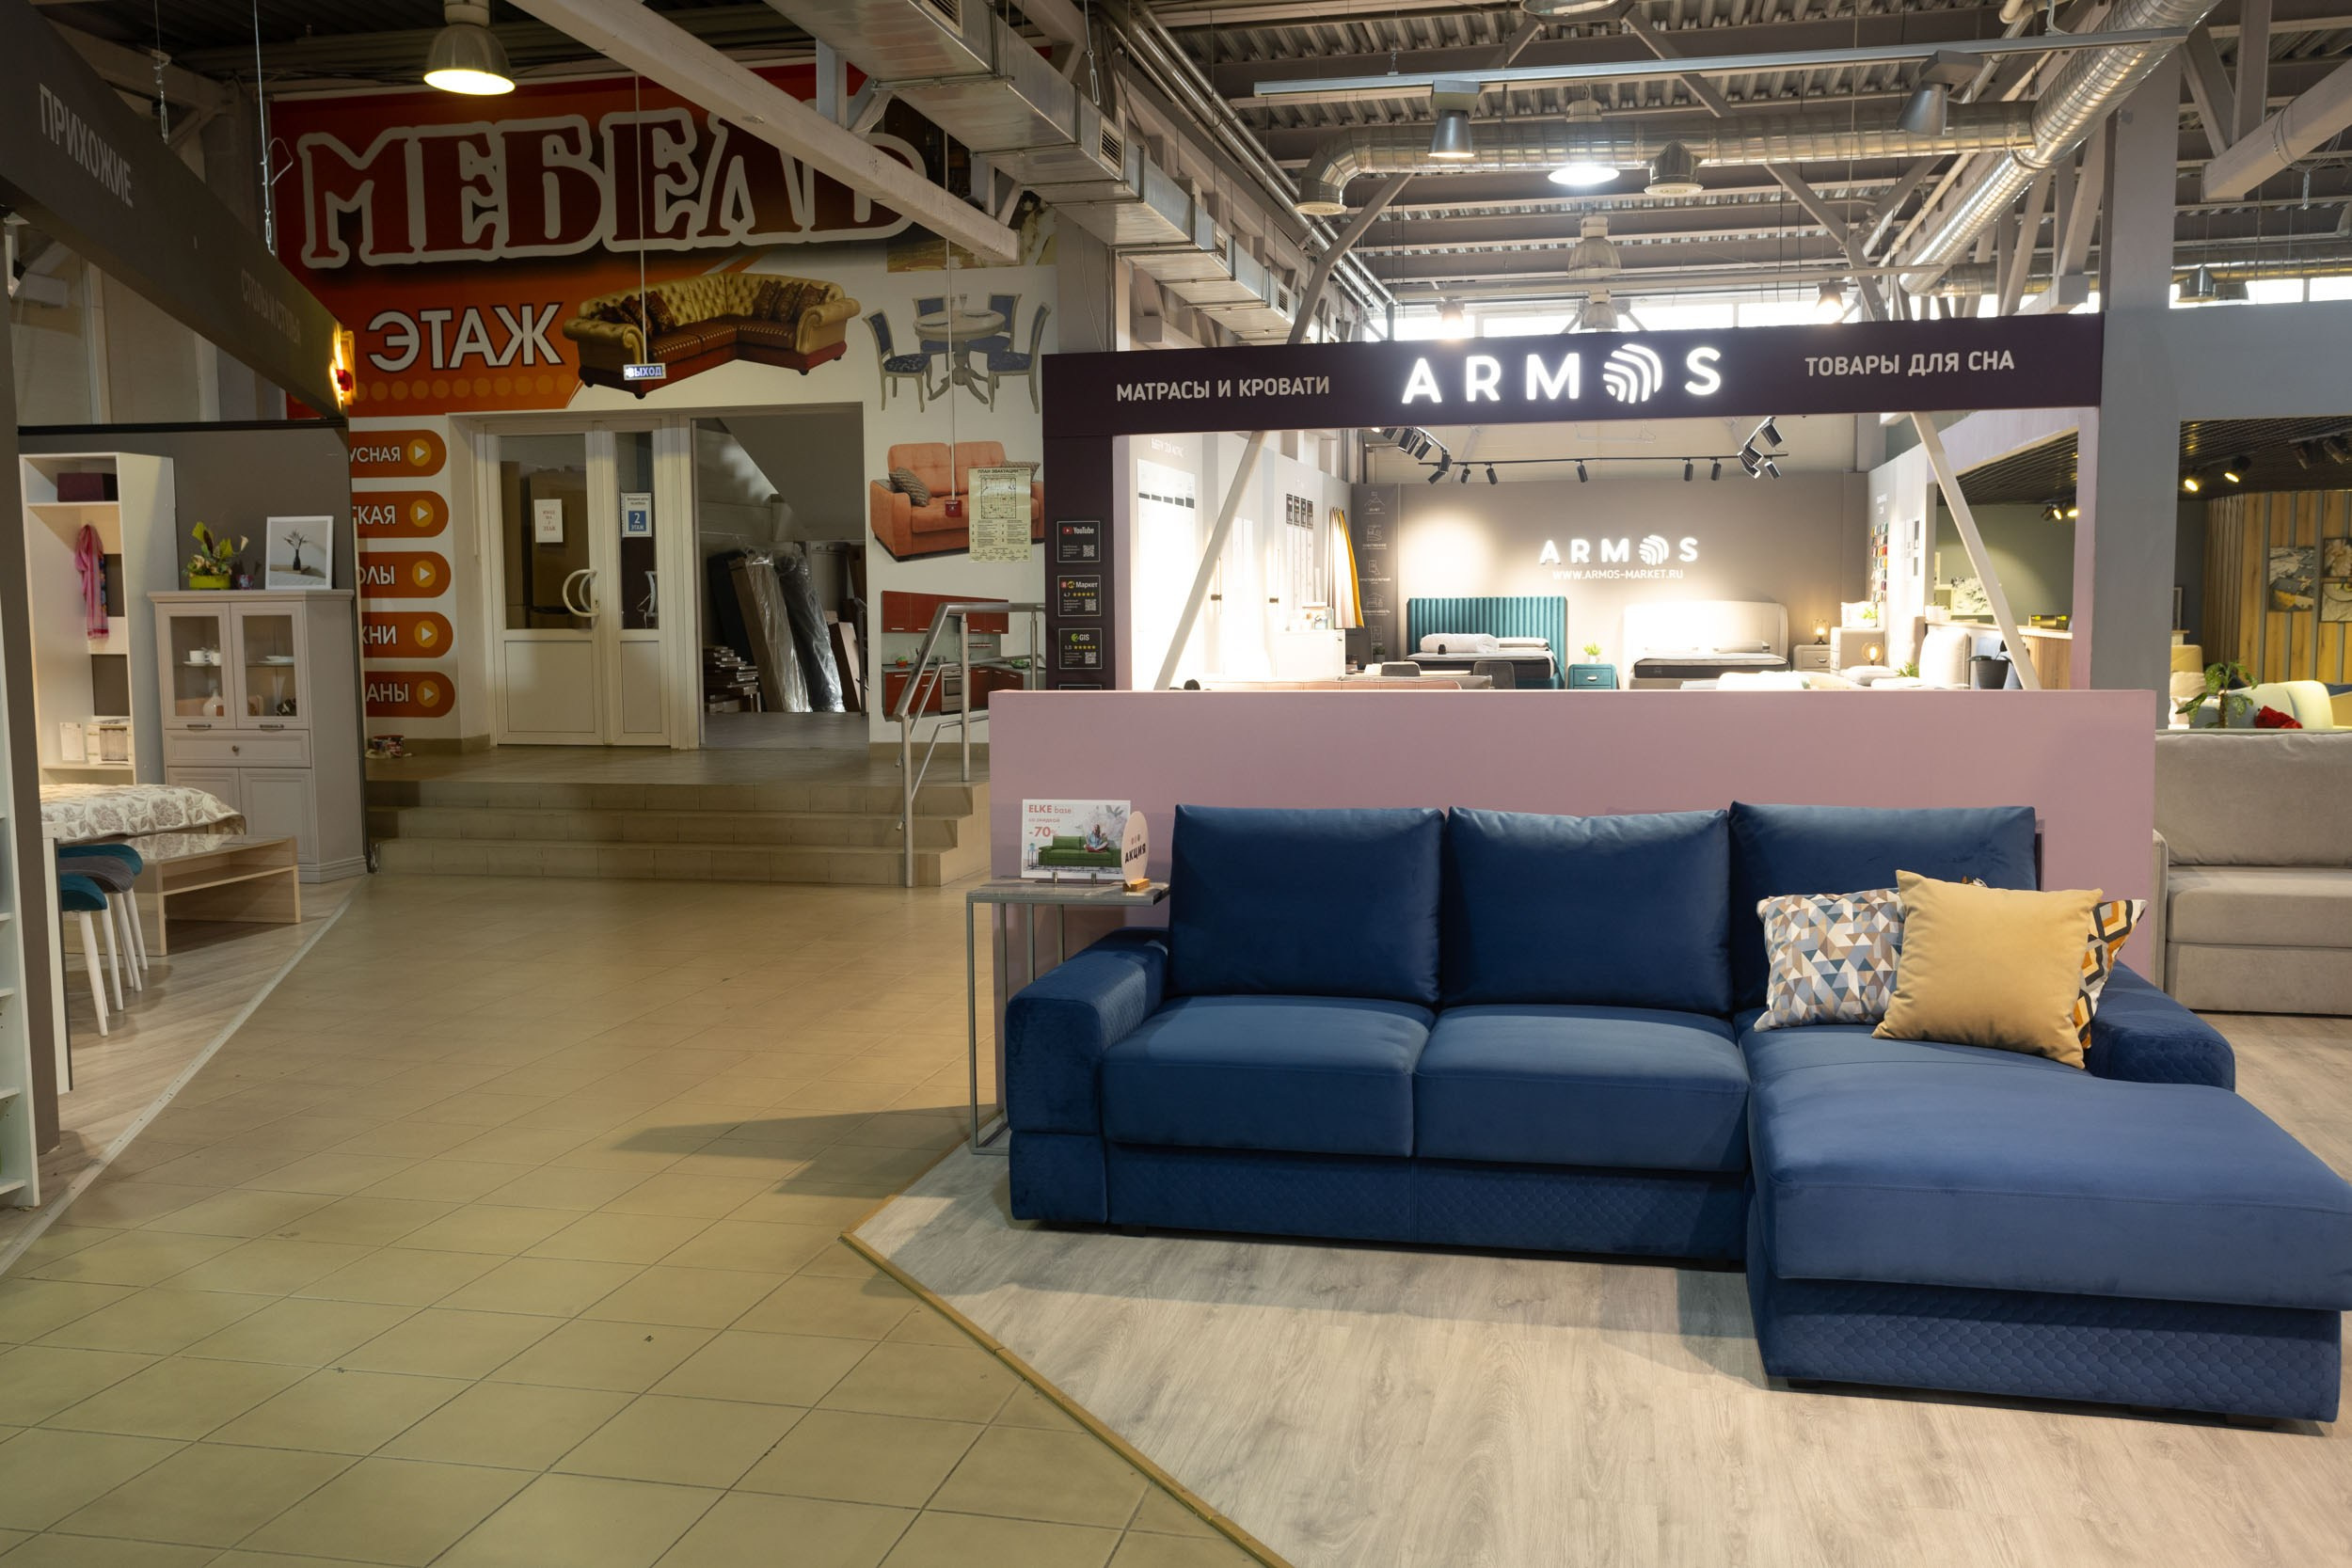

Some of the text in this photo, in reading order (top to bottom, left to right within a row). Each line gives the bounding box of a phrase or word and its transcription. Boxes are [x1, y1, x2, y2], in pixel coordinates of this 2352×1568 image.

[39, 82, 134, 208] ПРИХОЖИЕ
[366, 302, 565, 372] ЭТАЖ
[1804, 350, 2015, 376] ТОВАРЫ ДЛЯ СНА
[1402, 343, 1721, 404] ARMOS
[1117, 376, 1329, 402] МАТРАСЫ И КРОВАТИ
[349, 447, 401, 463] УСНАЯ
[353, 505, 396, 525] КАЯ
[634, 513, 641, 524] 2
[1073, 526, 1095, 534] YouTube
[1539, 534, 1698, 565] ARMOS
[358, 565, 395, 585] ОЛЫ
[1553, 569, 1683, 579] WWW.ARMOS-MARKET.RU
[1075, 580, 1098, 589] Маркет
[361, 625, 397, 645] ХНИ
[366, 683, 409, 703] АНЫ
[1028, 804, 1072, 814] ELKE base
[1124, 843, 1146, 863] АКЦИЯ
